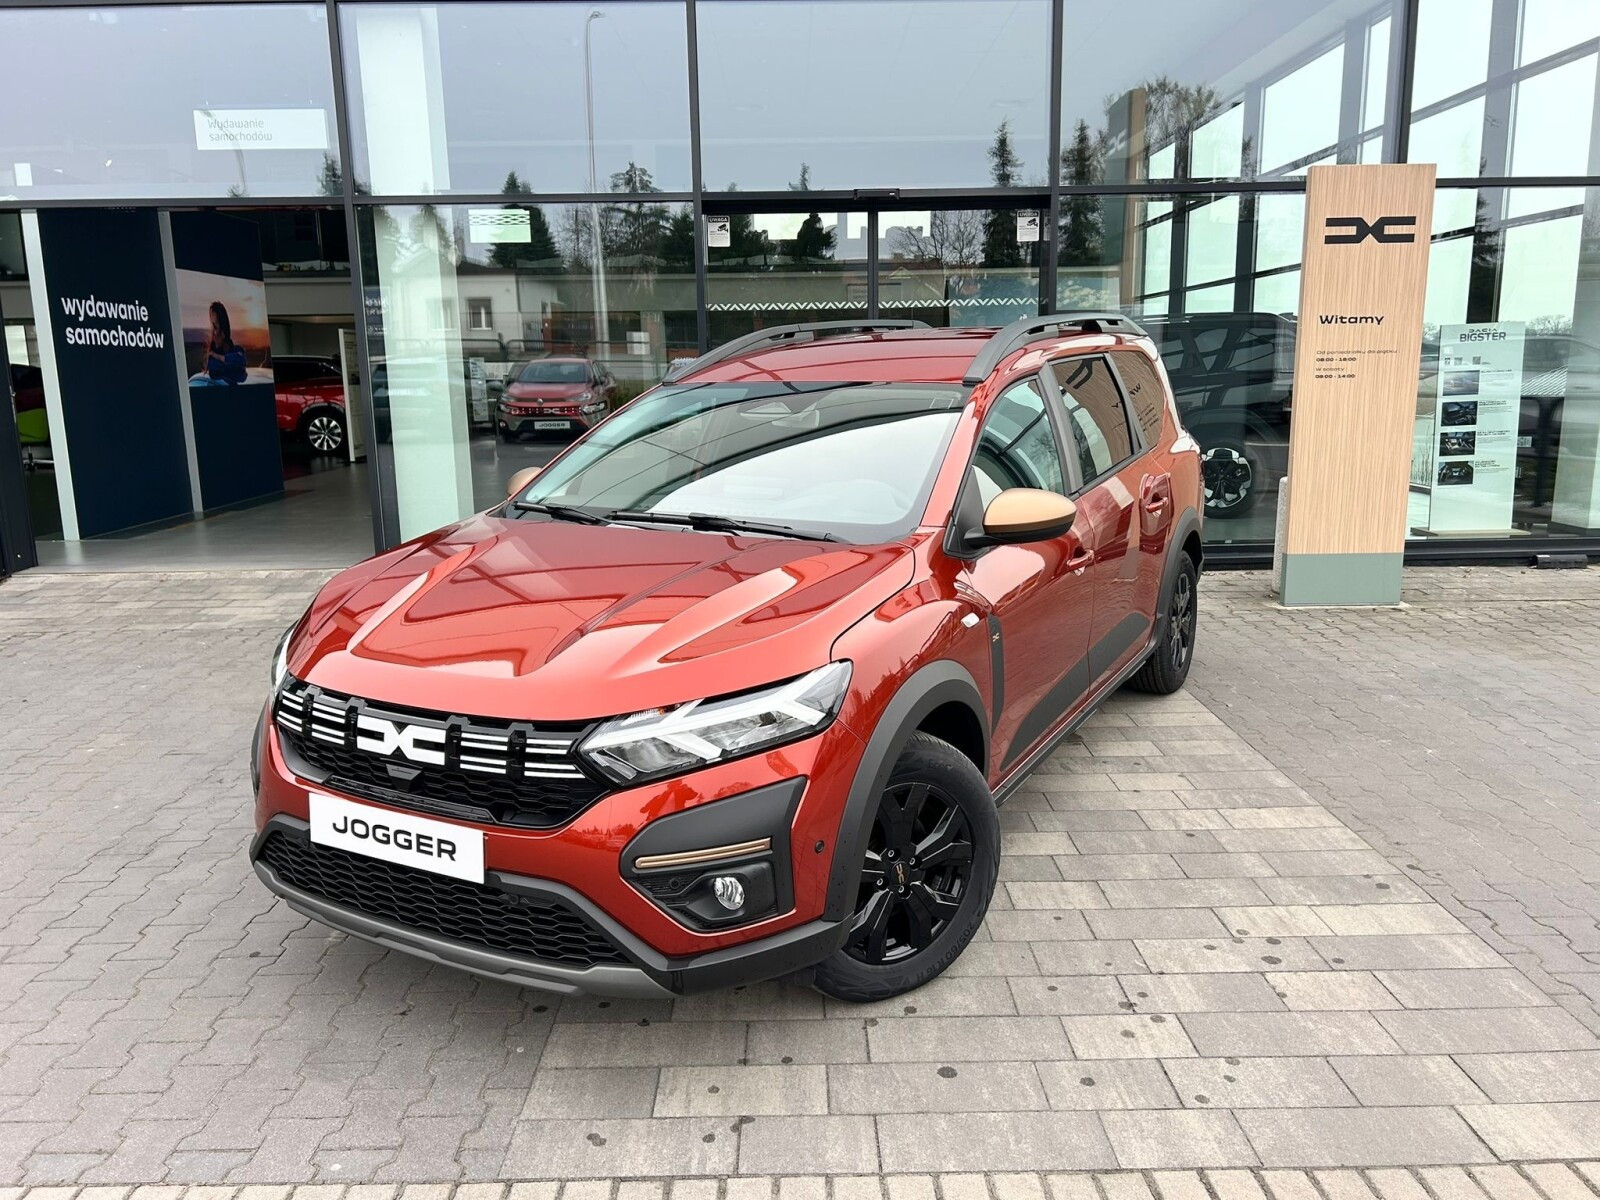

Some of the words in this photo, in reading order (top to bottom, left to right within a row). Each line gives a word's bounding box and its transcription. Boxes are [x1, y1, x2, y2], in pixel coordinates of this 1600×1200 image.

[207, 119, 264, 130] Wydawanie
[209, 131, 273, 141] samochodów
[61, 294, 149, 321] wydawanie
[1319, 314, 1385, 326] Witamy
[65, 325, 164, 349] samochodów
[1459, 332, 1507, 343] BIGSTER
[332, 815, 457, 862] JOGGER
